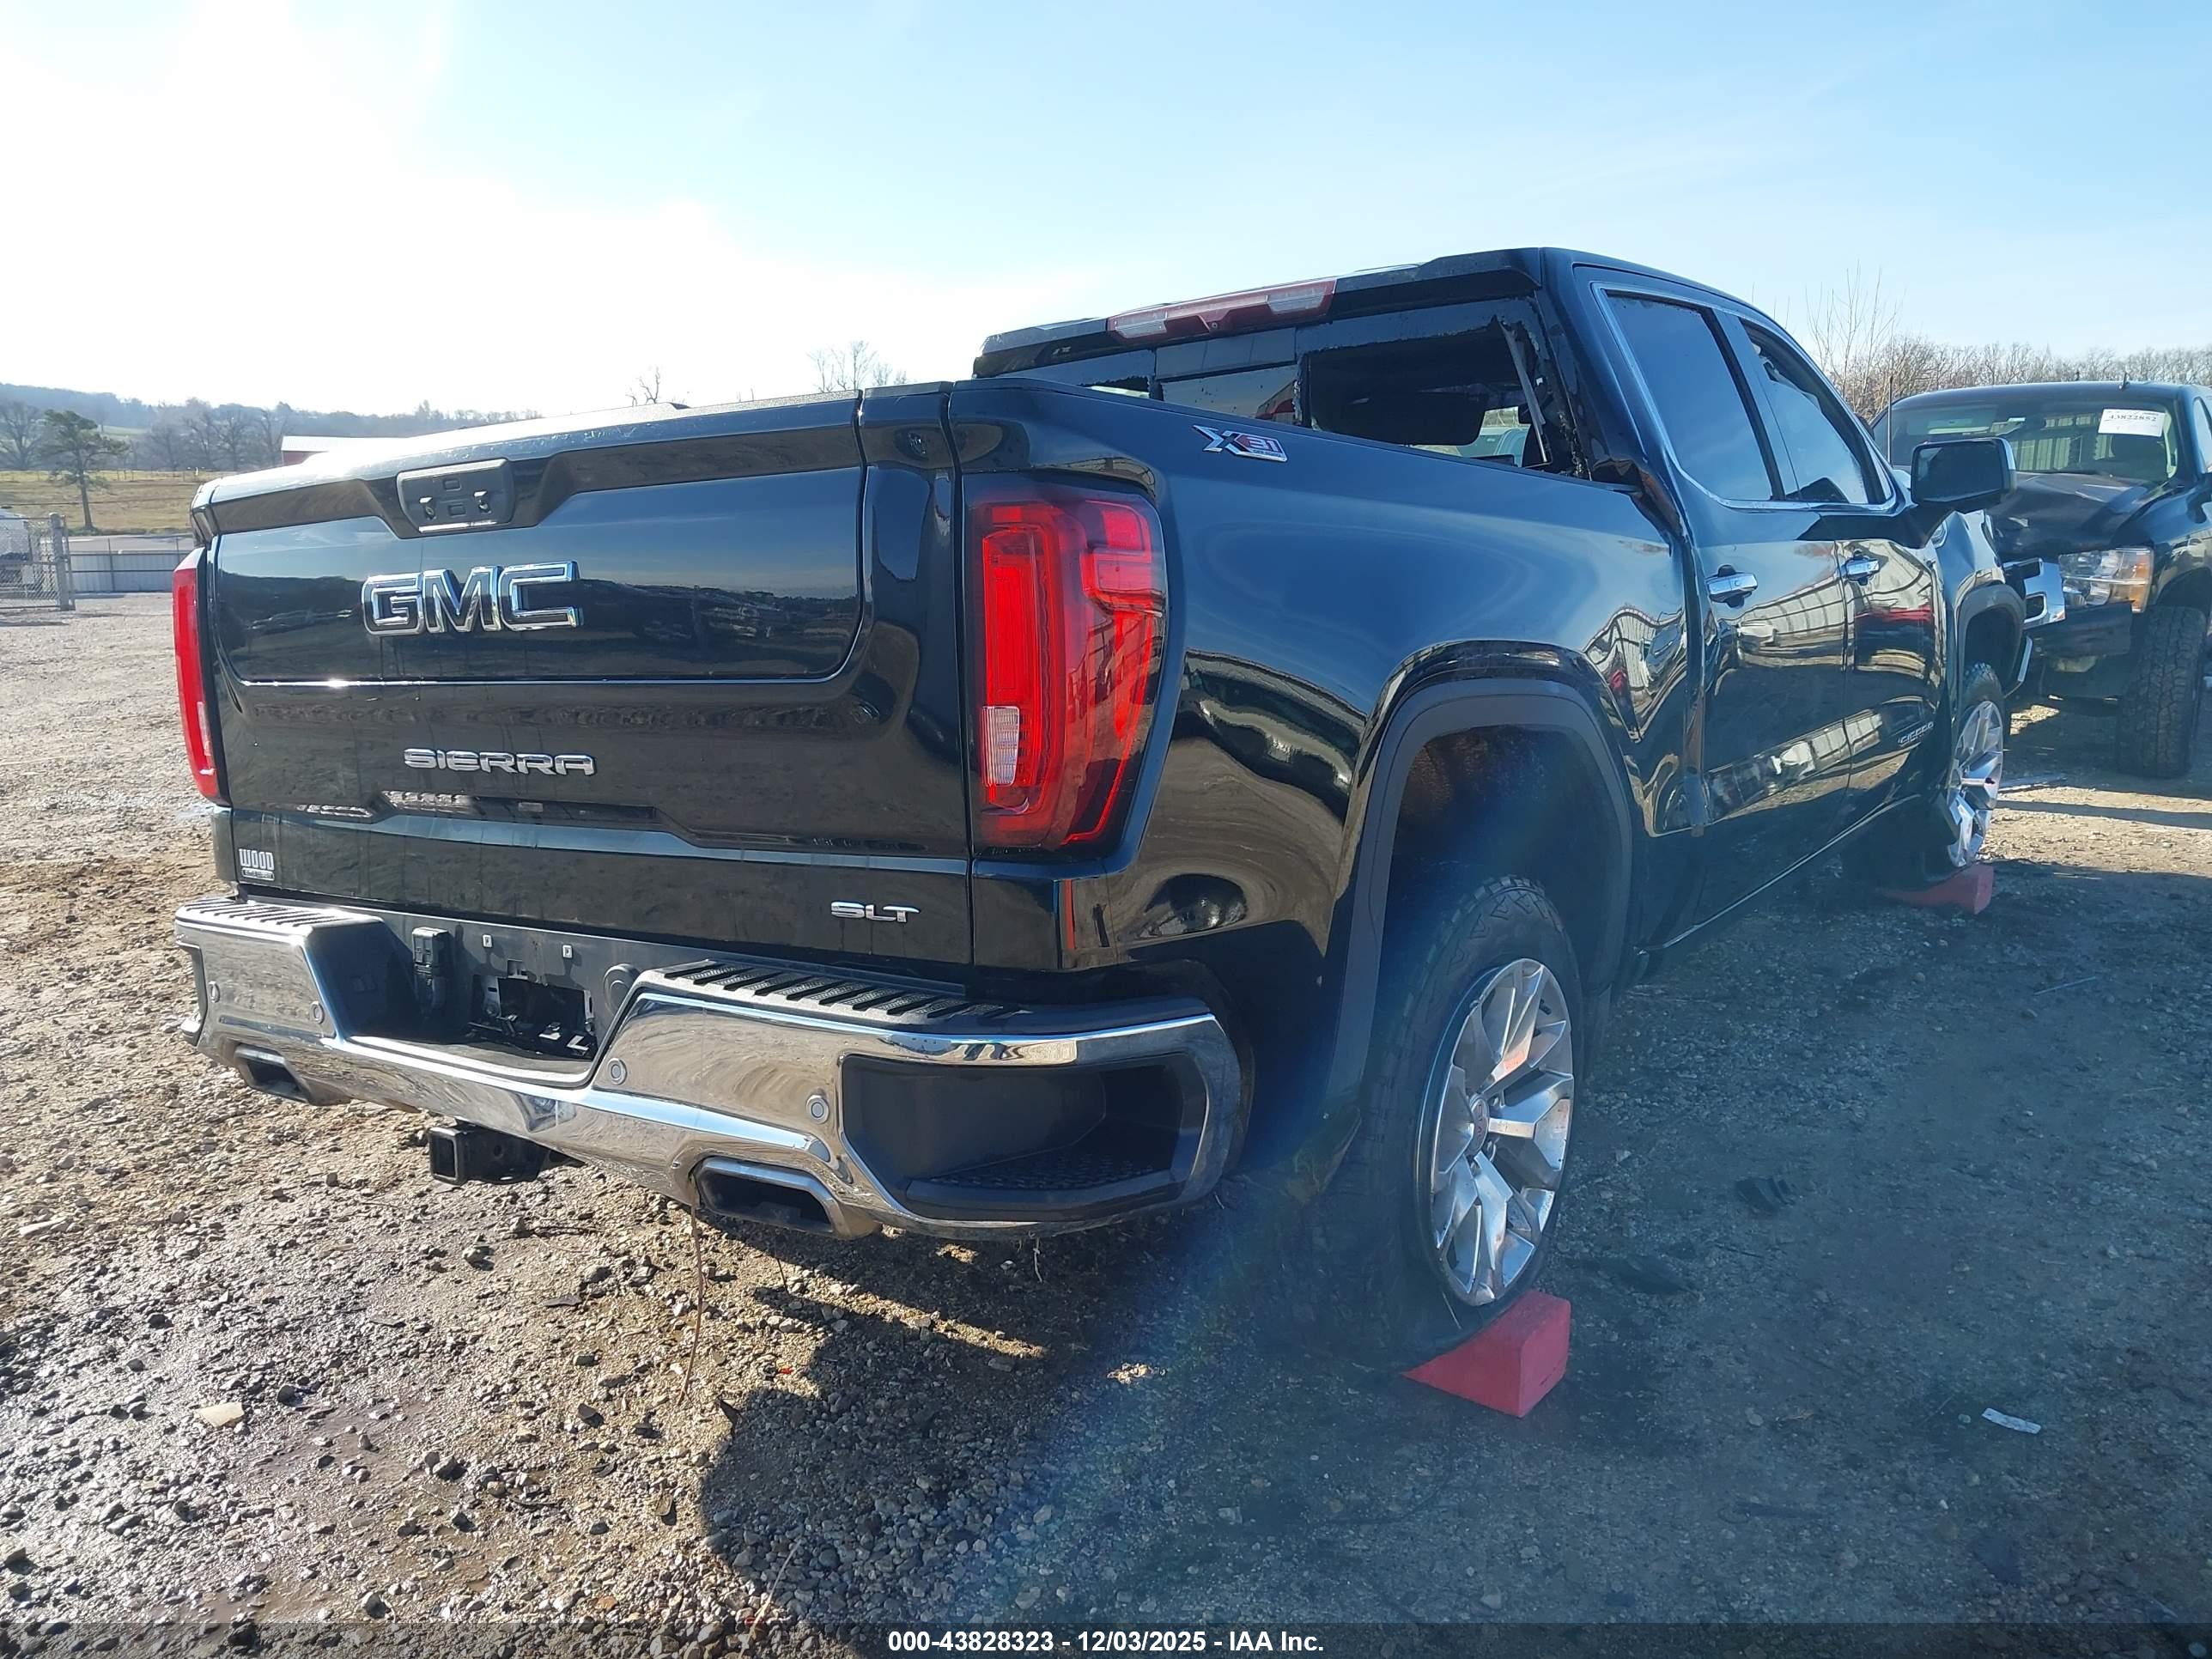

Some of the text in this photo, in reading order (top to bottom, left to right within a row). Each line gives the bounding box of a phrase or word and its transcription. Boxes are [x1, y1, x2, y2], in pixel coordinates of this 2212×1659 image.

[1192, 424, 1287, 462] X31
[362, 561, 583, 635] GMC
[404, 748, 595, 775] SIERRA
[239, 848, 275, 871] WOOD
[830, 901, 920, 923] SLT
